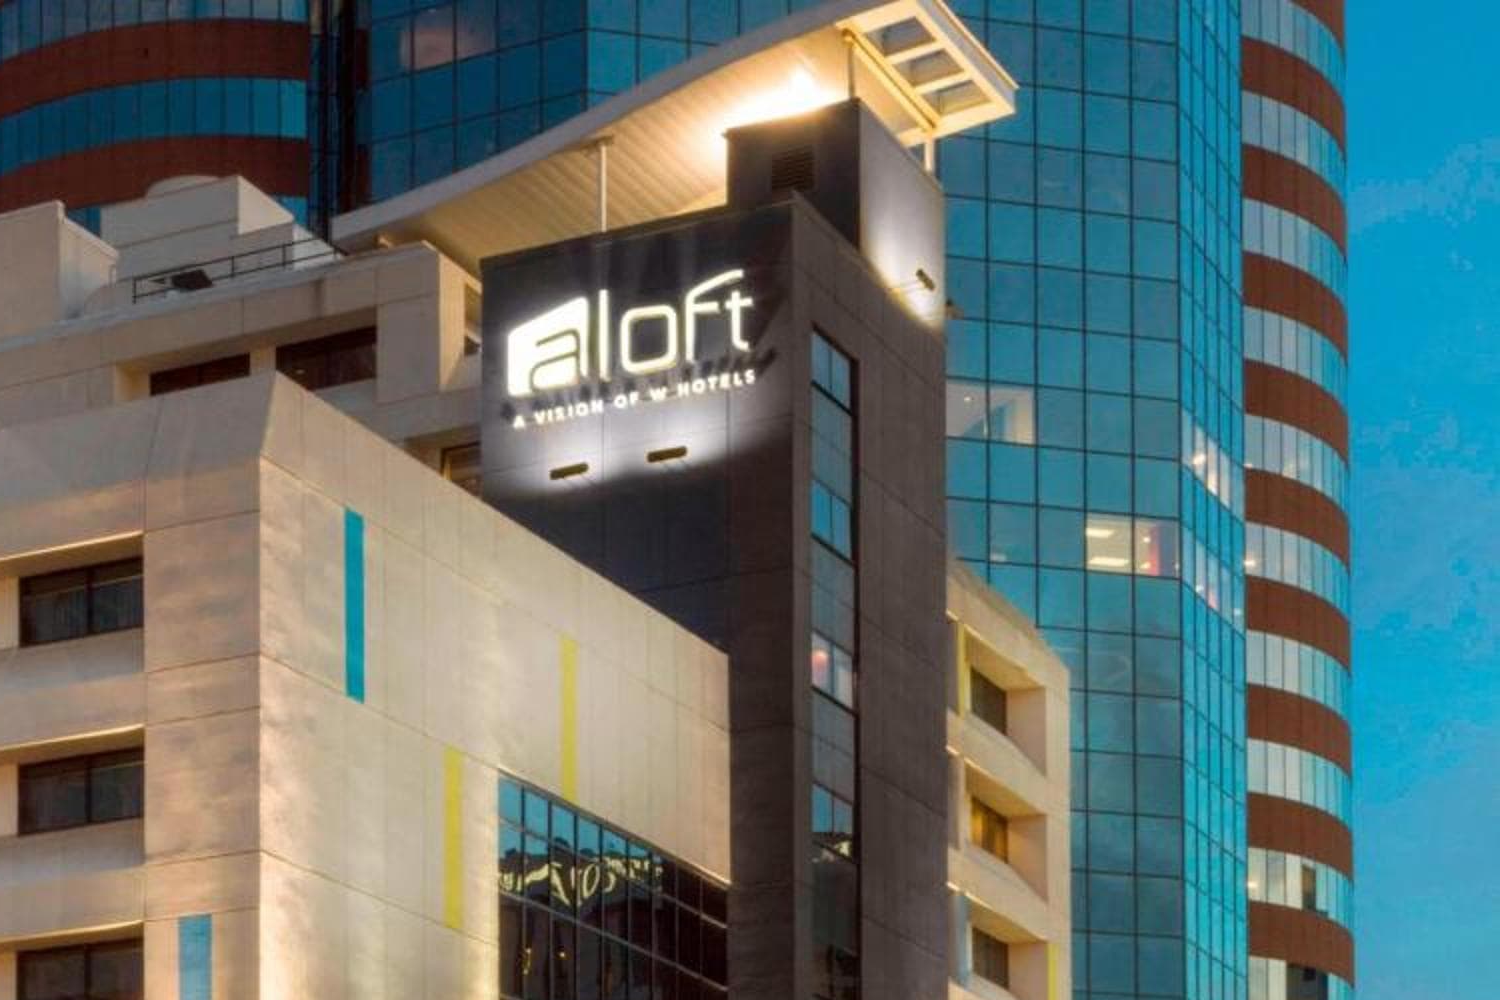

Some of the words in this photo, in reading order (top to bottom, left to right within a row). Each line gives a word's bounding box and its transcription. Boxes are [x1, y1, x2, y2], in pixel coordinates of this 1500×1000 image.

[507, 268, 754, 396] aloft
[512, 415, 526, 430] A
[534, 399, 605, 426] VISION
[614, 392, 640, 410] OF
[649, 387, 669, 403] W
[677, 369, 757, 398] HOTELS
